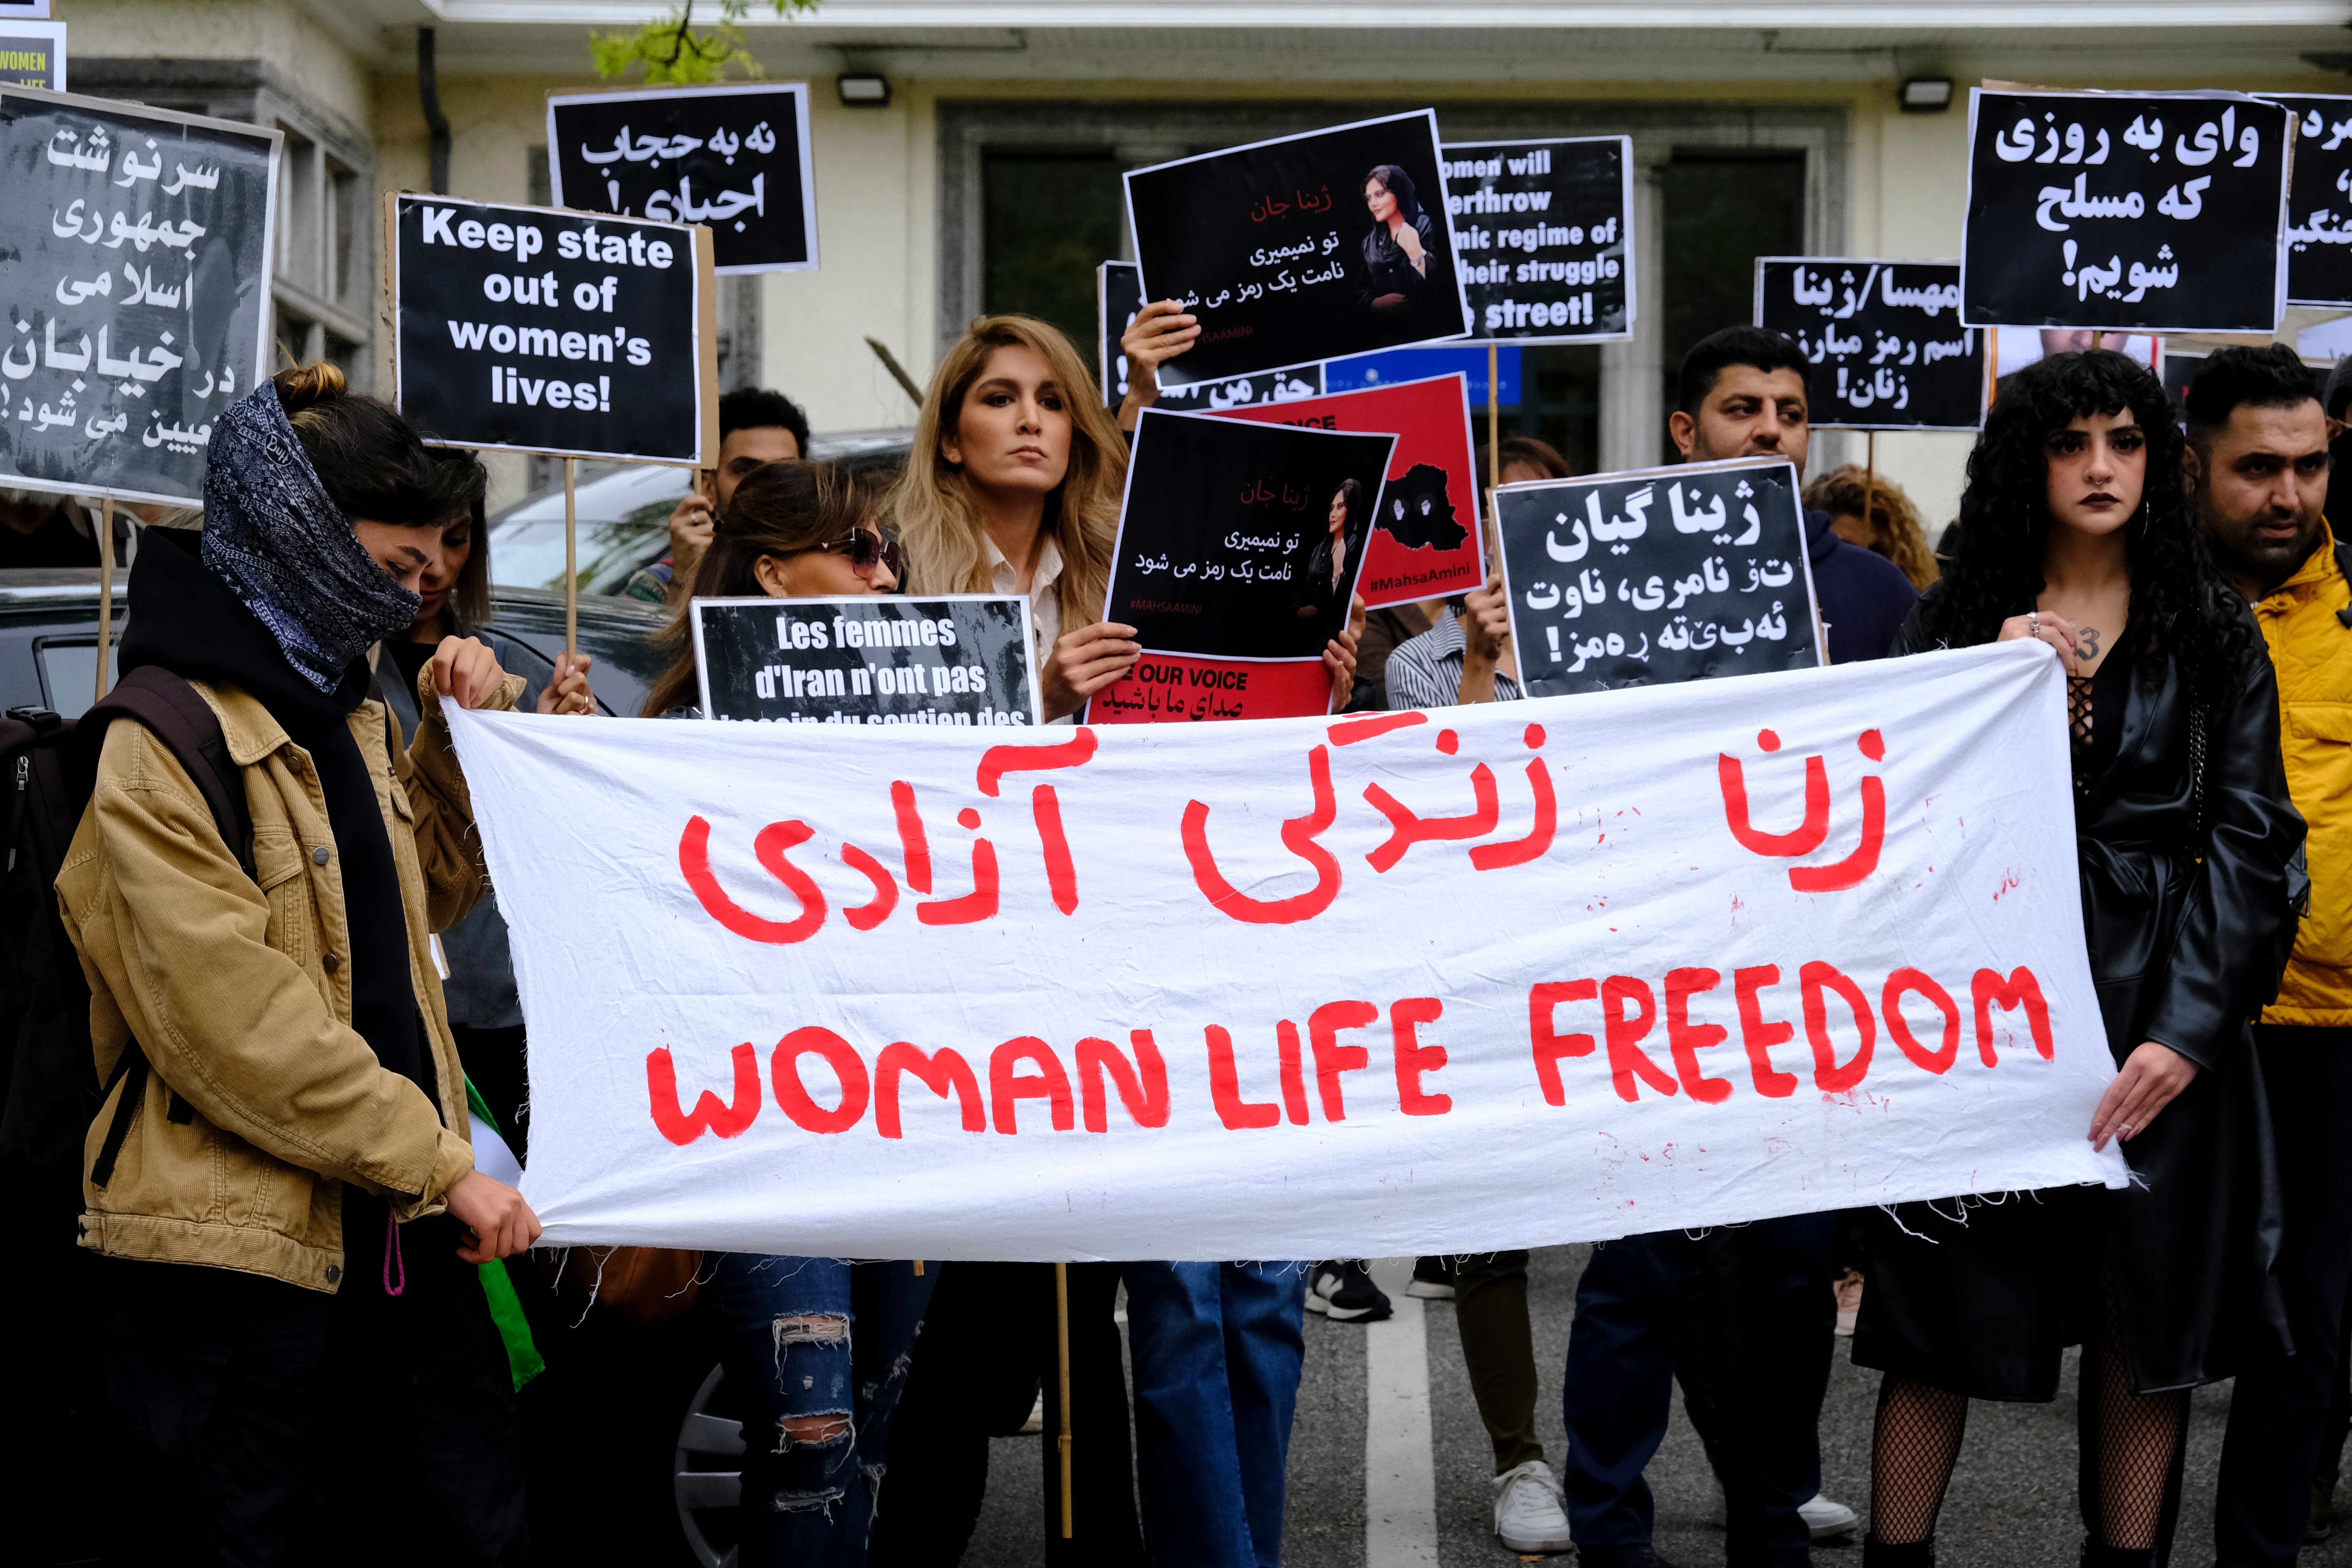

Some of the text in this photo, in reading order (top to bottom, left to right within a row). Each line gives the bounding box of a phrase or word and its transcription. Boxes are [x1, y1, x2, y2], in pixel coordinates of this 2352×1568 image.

[581, 121, 776, 178] نه به حجاب
[1995, 105, 2260, 167] وای به روزی
[1440, 149, 1551, 179] omen will
[1252, 185, 1332, 222] ژینا جان
[1449, 186, 1552, 215] erthrow
[2035, 172, 2212, 232] که مسلح
[53, 198, 206, 261] جمهوری
[422, 206, 674, 269] Keep state
[1497, 221, 1584, 253] regime
[1591, 217, 1617, 244] of
[1249, 231, 1339, 267] تو نمیمیری
[1268, 269, 1297, 293] یک
[1301, 261, 1345, 284] نامت
[1460, 253, 1620, 286] heir struggle
[2062, 239, 2179, 303] شویم!
[483, 271, 618, 313] out of
[1206, 289, 1230, 308] می
[1236, 283, 1263, 303] رمز
[1485, 292, 1593, 329] street!
[1, 316, 235, 399] در خیابان
[1868, 329, 1917, 366] رمز
[1923, 328, 1974, 366] اسم
[492, 366, 610, 413] lives!
[1836, 367, 1909, 410] زنان!
[85, 412, 128, 440] می
[1240, 479, 1310, 511] ژینا جان
[1545, 479, 1761, 562] ژینا گیان
[1224, 531, 1300, 555] تو نمیمیری
[1135, 553, 1292, 584] نامت یک رمز می شود
[1370, 562, 1471, 592] #MahsaAmini
[1130, 598, 1203, 614] #MAHSAAMINI
[1526, 569, 1606, 619] ناوت
[775, 616, 957, 650] Les femmes
[754, 663, 986, 699] d'Iran n'ont pas
[1139, 663, 1184, 685] OUR
[1189, 668, 1249, 691] VOICE
[1103, 685, 1243, 721] صدای ما باشید
[679, 711, 1886, 946] زن زندگی آزادی
[646, 960, 2054, 1146] WOMAN LIFE FREEDOM
